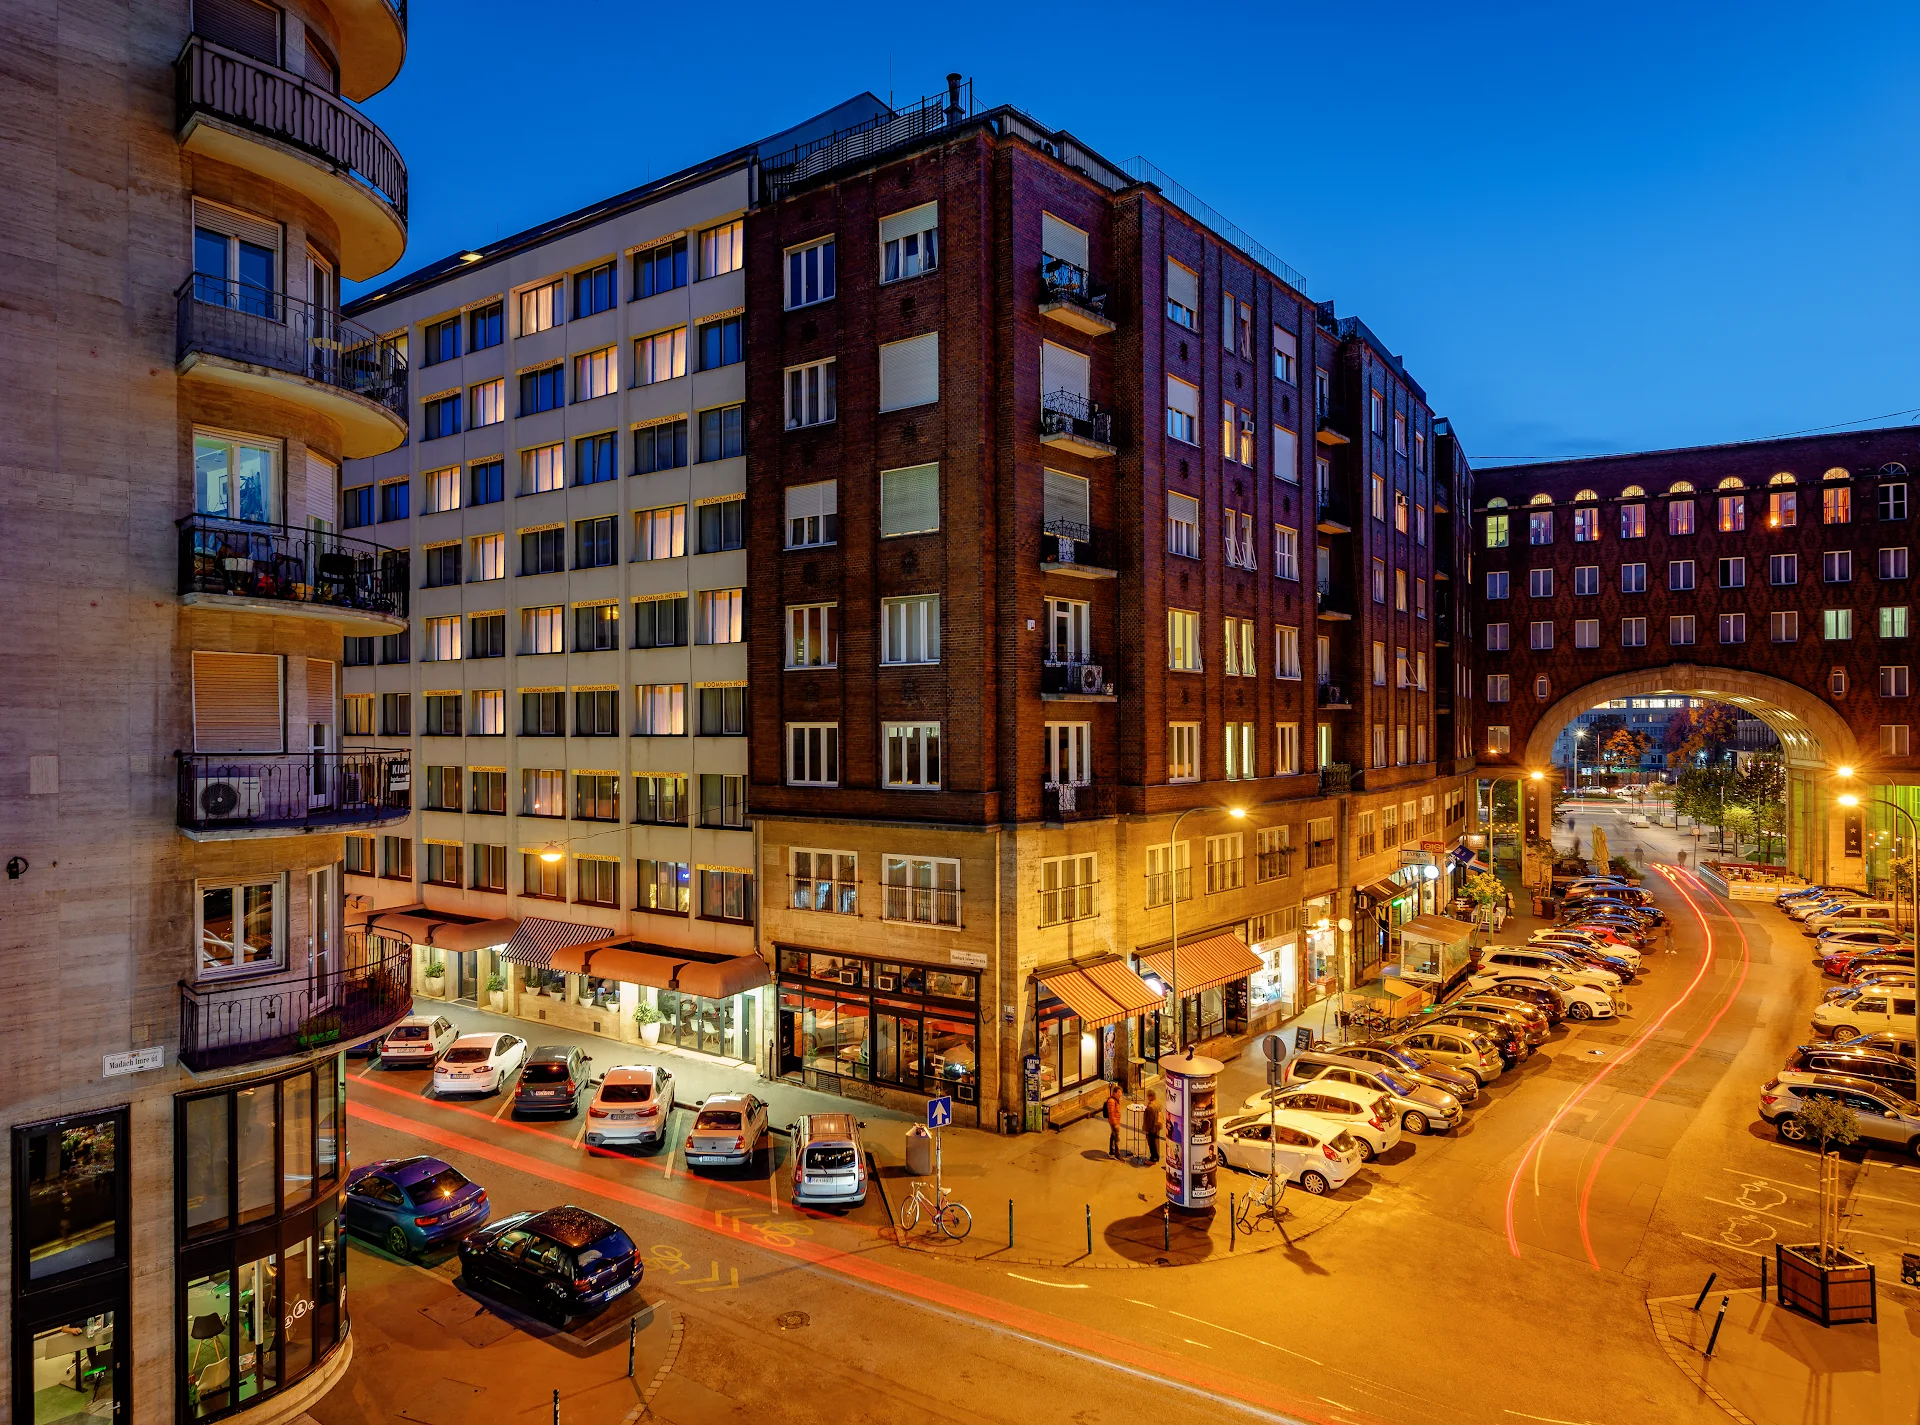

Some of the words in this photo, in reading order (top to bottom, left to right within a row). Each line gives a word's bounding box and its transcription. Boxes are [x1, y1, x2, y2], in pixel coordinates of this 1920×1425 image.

[633, 240, 659, 253] ROOMbach
[660, 233, 676, 243] HOTEL
[702, 310, 732, 323] ROOMbach
[545, 358, 558, 367] HOTEL
[636, 418, 664, 429] ROOMbach
[664, 414, 681, 423] HOTEL
[702, 495, 732, 505] ROOMbach
[545, 522, 560, 530] HOTEL
[577, 599, 602, 607] ROOMbach
[637, 594, 664, 602] ROOMbach
[1423, 843, 1443, 854] GIGI
[704, 864, 734, 873] ROOMbach
[109, 1059, 134, 1069] Madách
[135, 1057, 150, 1065] Imre
